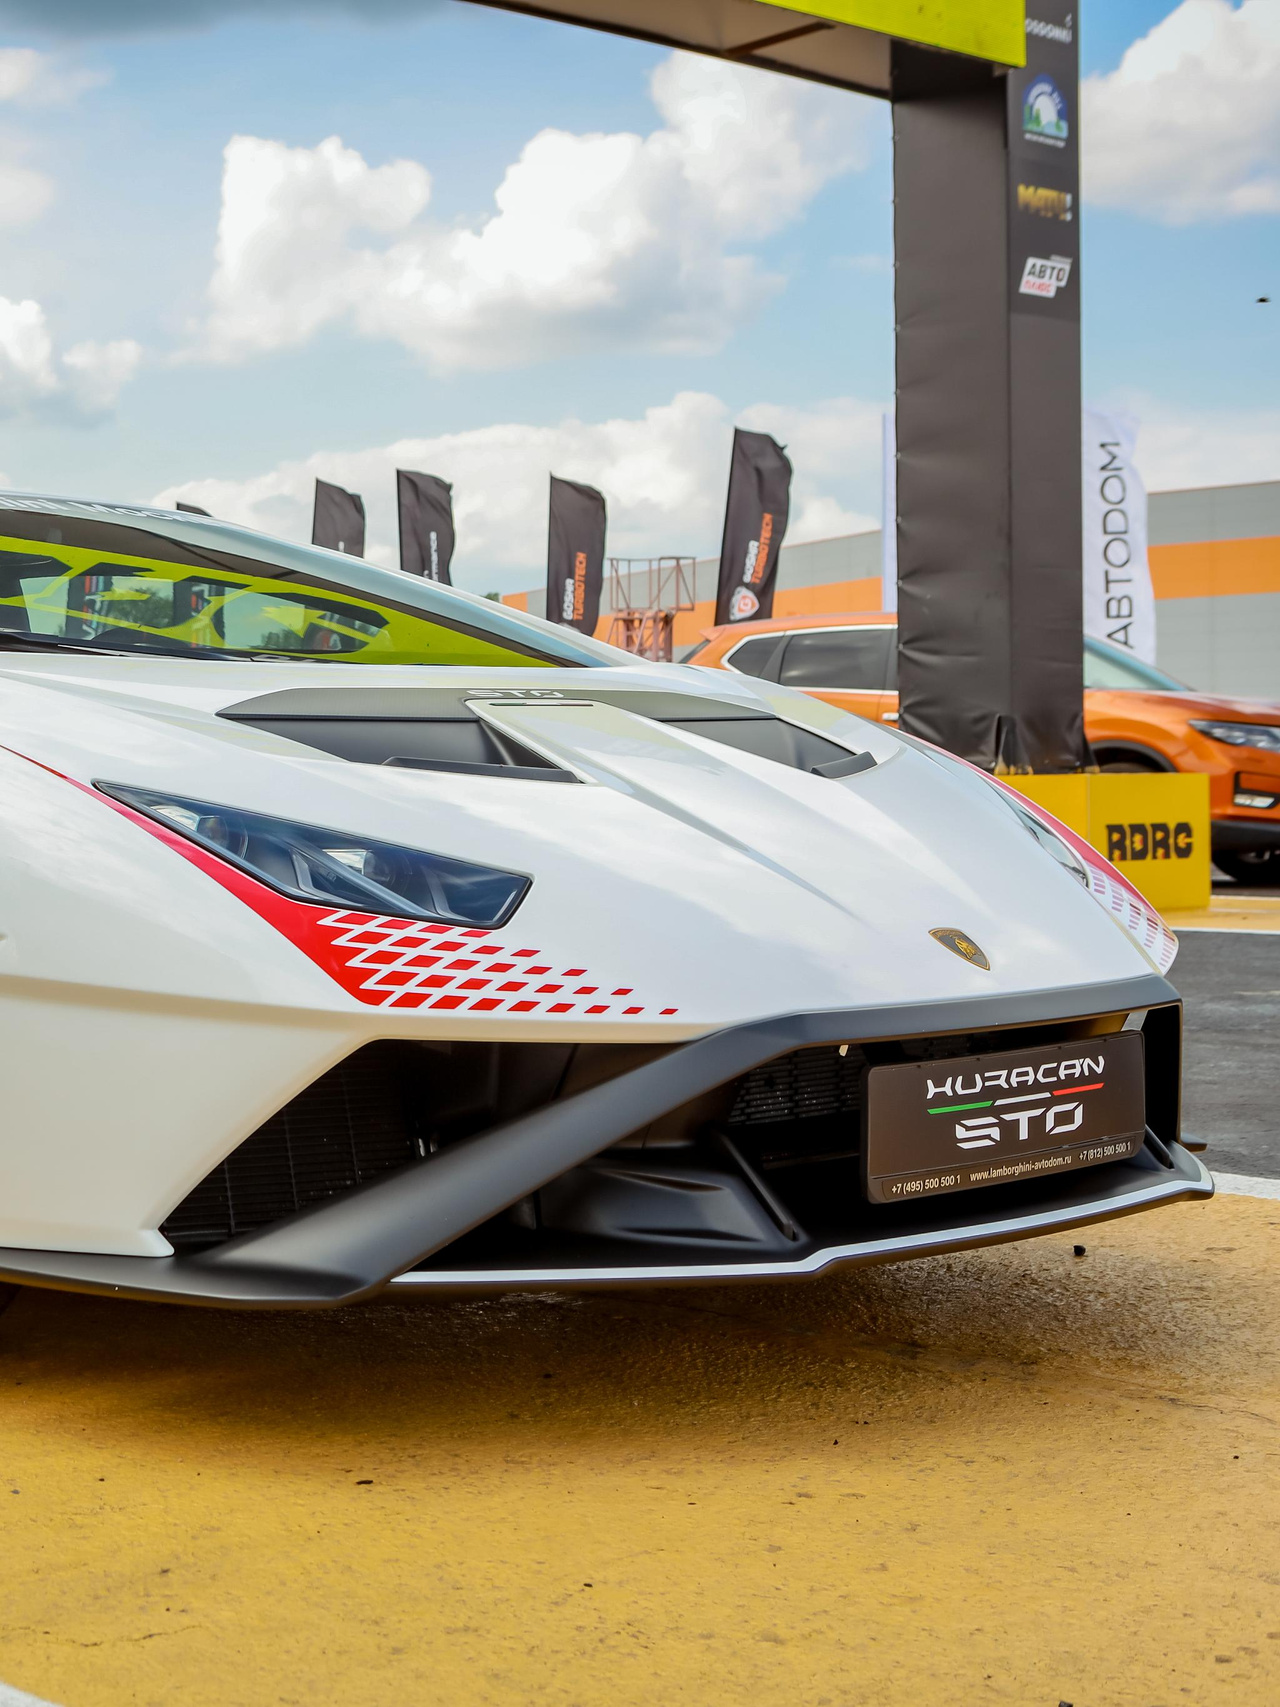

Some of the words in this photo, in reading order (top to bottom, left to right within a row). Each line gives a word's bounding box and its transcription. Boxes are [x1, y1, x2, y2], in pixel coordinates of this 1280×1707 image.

[1027, 261, 1066, 283] АВТО
[466, 689, 564, 698] STO
[1105, 822, 1193, 862] RDRC
[955, 1101, 1083, 1150] STO
[891, 1183, 902, 1194] +7
[903, 1180, 923, 1195] (495)
[924, 1178, 940, 1190] 500
[940, 1176, 955, 1188] 500
[956, 1174, 961, 1184] 1
[969, 1154, 1072, 1182] www.lamborghini-avtodom.ru
[1079, 1150, 1088, 1161] +7
[1087, 1147, 1103, 1162] (812)
[1103, 1144, 1115, 1157] 500
[1115, 1142, 1127, 1154] 500
[1126, 1141, 1131, 1151] 1
